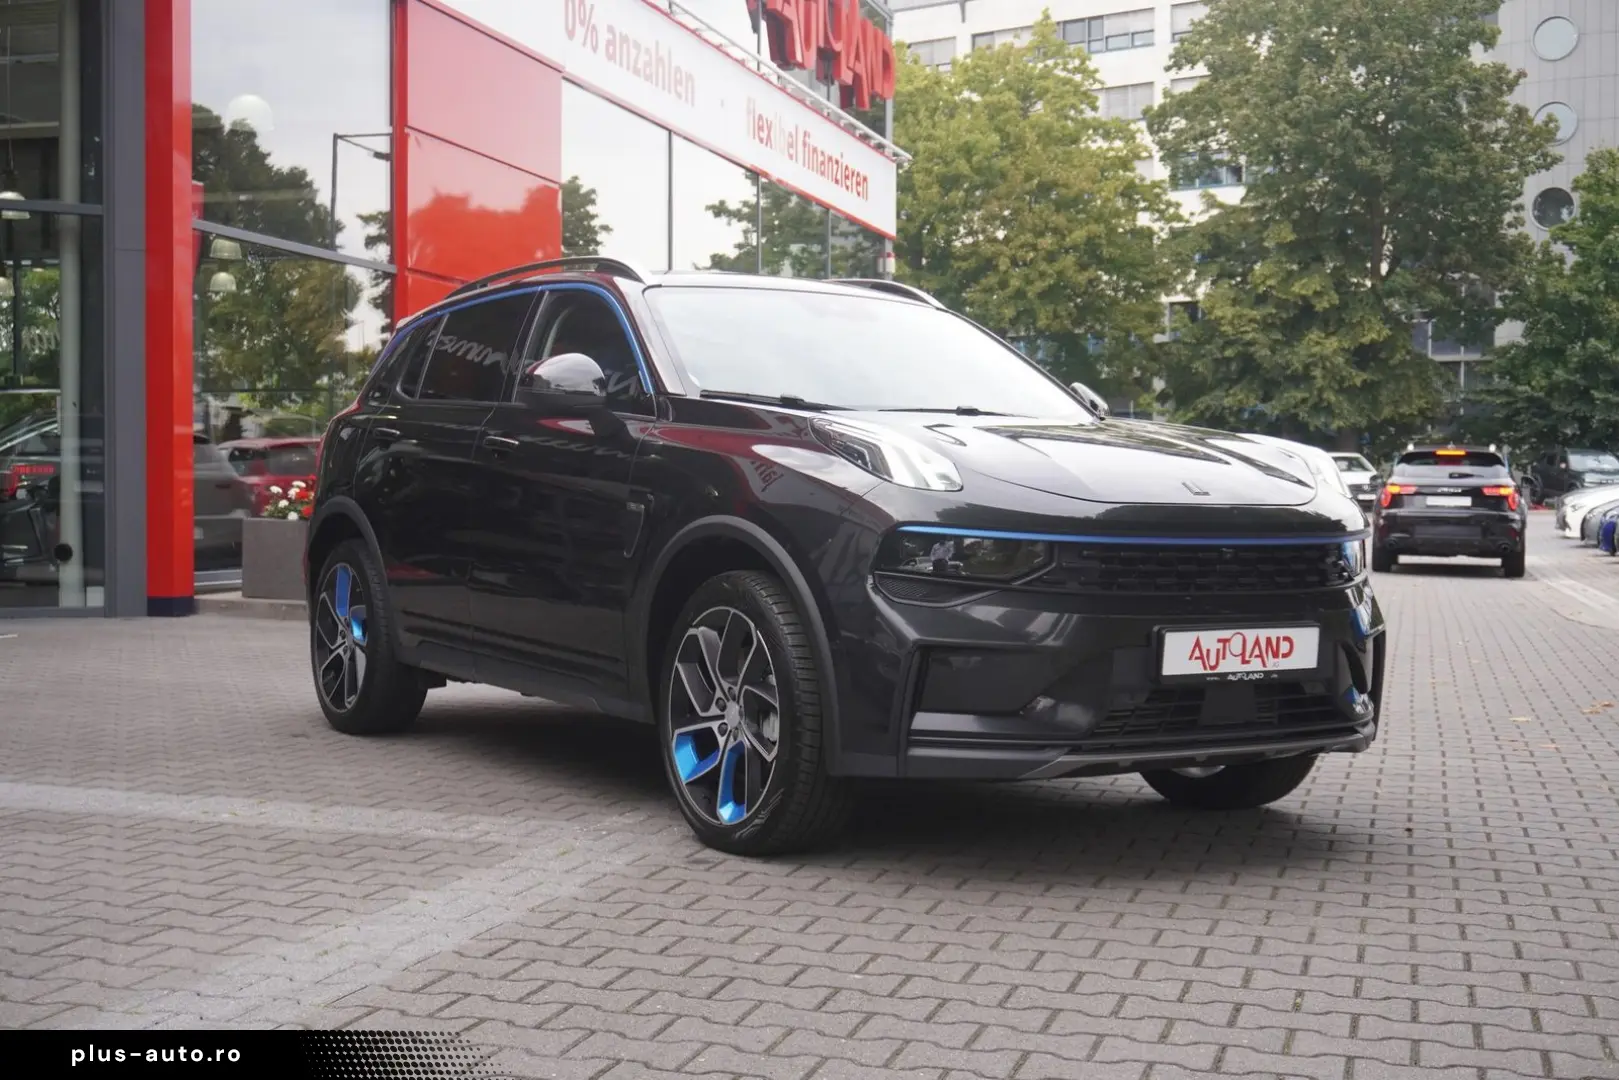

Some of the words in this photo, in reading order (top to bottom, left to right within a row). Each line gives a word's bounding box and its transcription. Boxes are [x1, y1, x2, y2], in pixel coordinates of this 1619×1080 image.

[564, 0, 599, 54] 0%
[605, 24, 695, 107] anzahlen
[746, 96, 799, 163] flexibel
[802, 130, 868, 201] finanzieren
[1189, 632, 1294, 671] AUTOLAND
